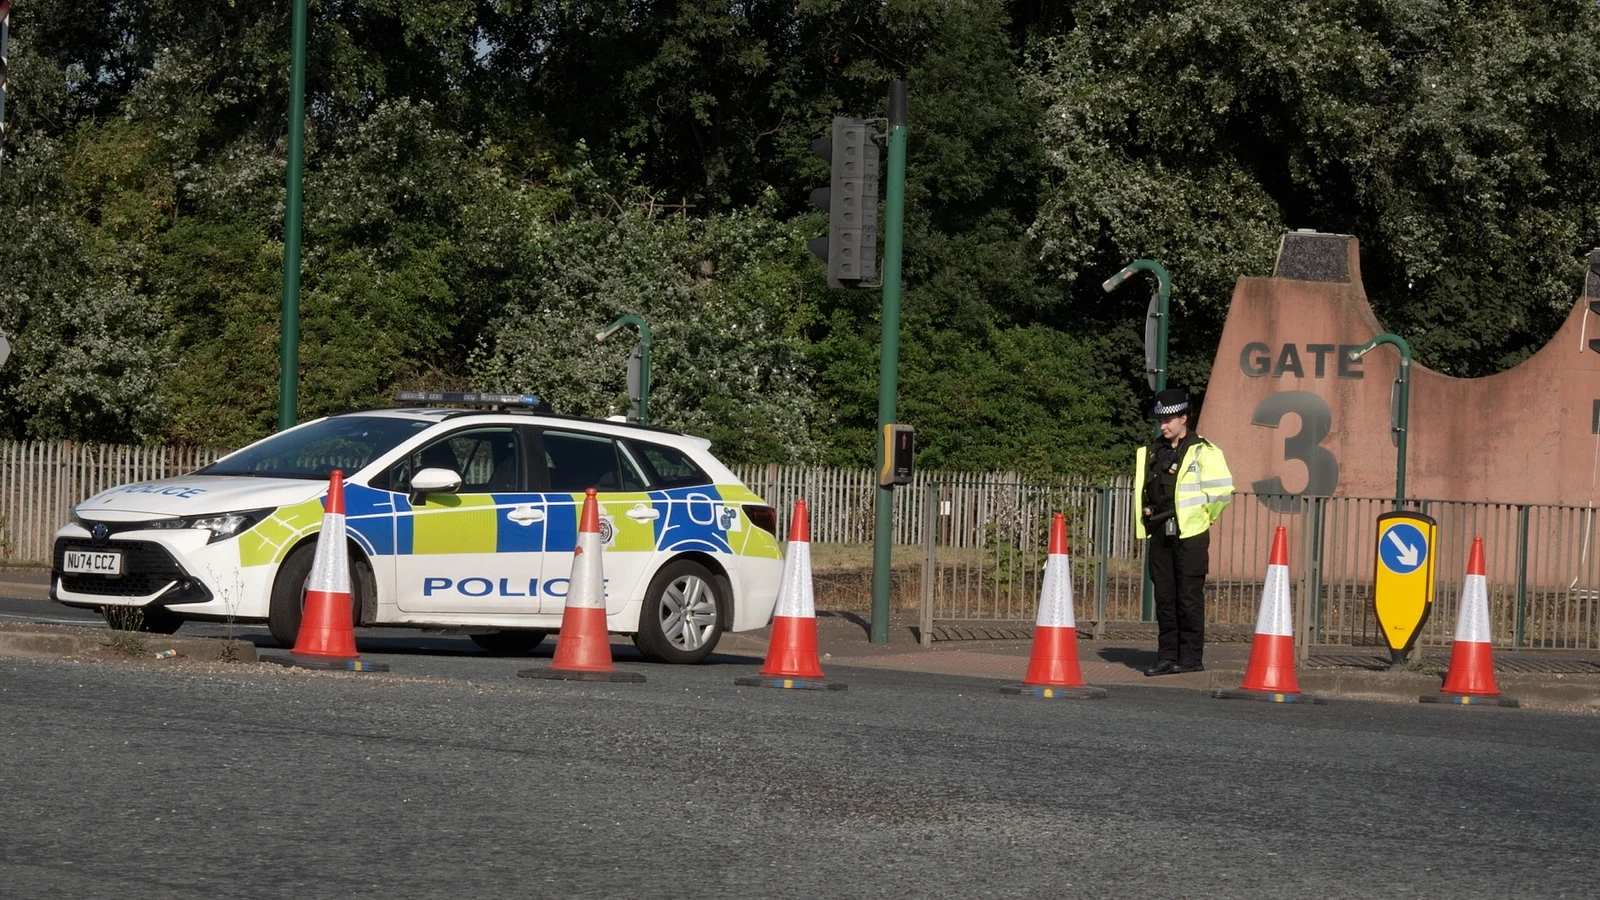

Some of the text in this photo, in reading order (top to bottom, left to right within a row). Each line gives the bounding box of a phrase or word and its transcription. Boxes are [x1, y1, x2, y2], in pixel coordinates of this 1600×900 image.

[1239, 341, 1364, 380] GATE
[1250, 390, 1338, 514] 3
[67, 553, 115, 570] NU74 CCZ
